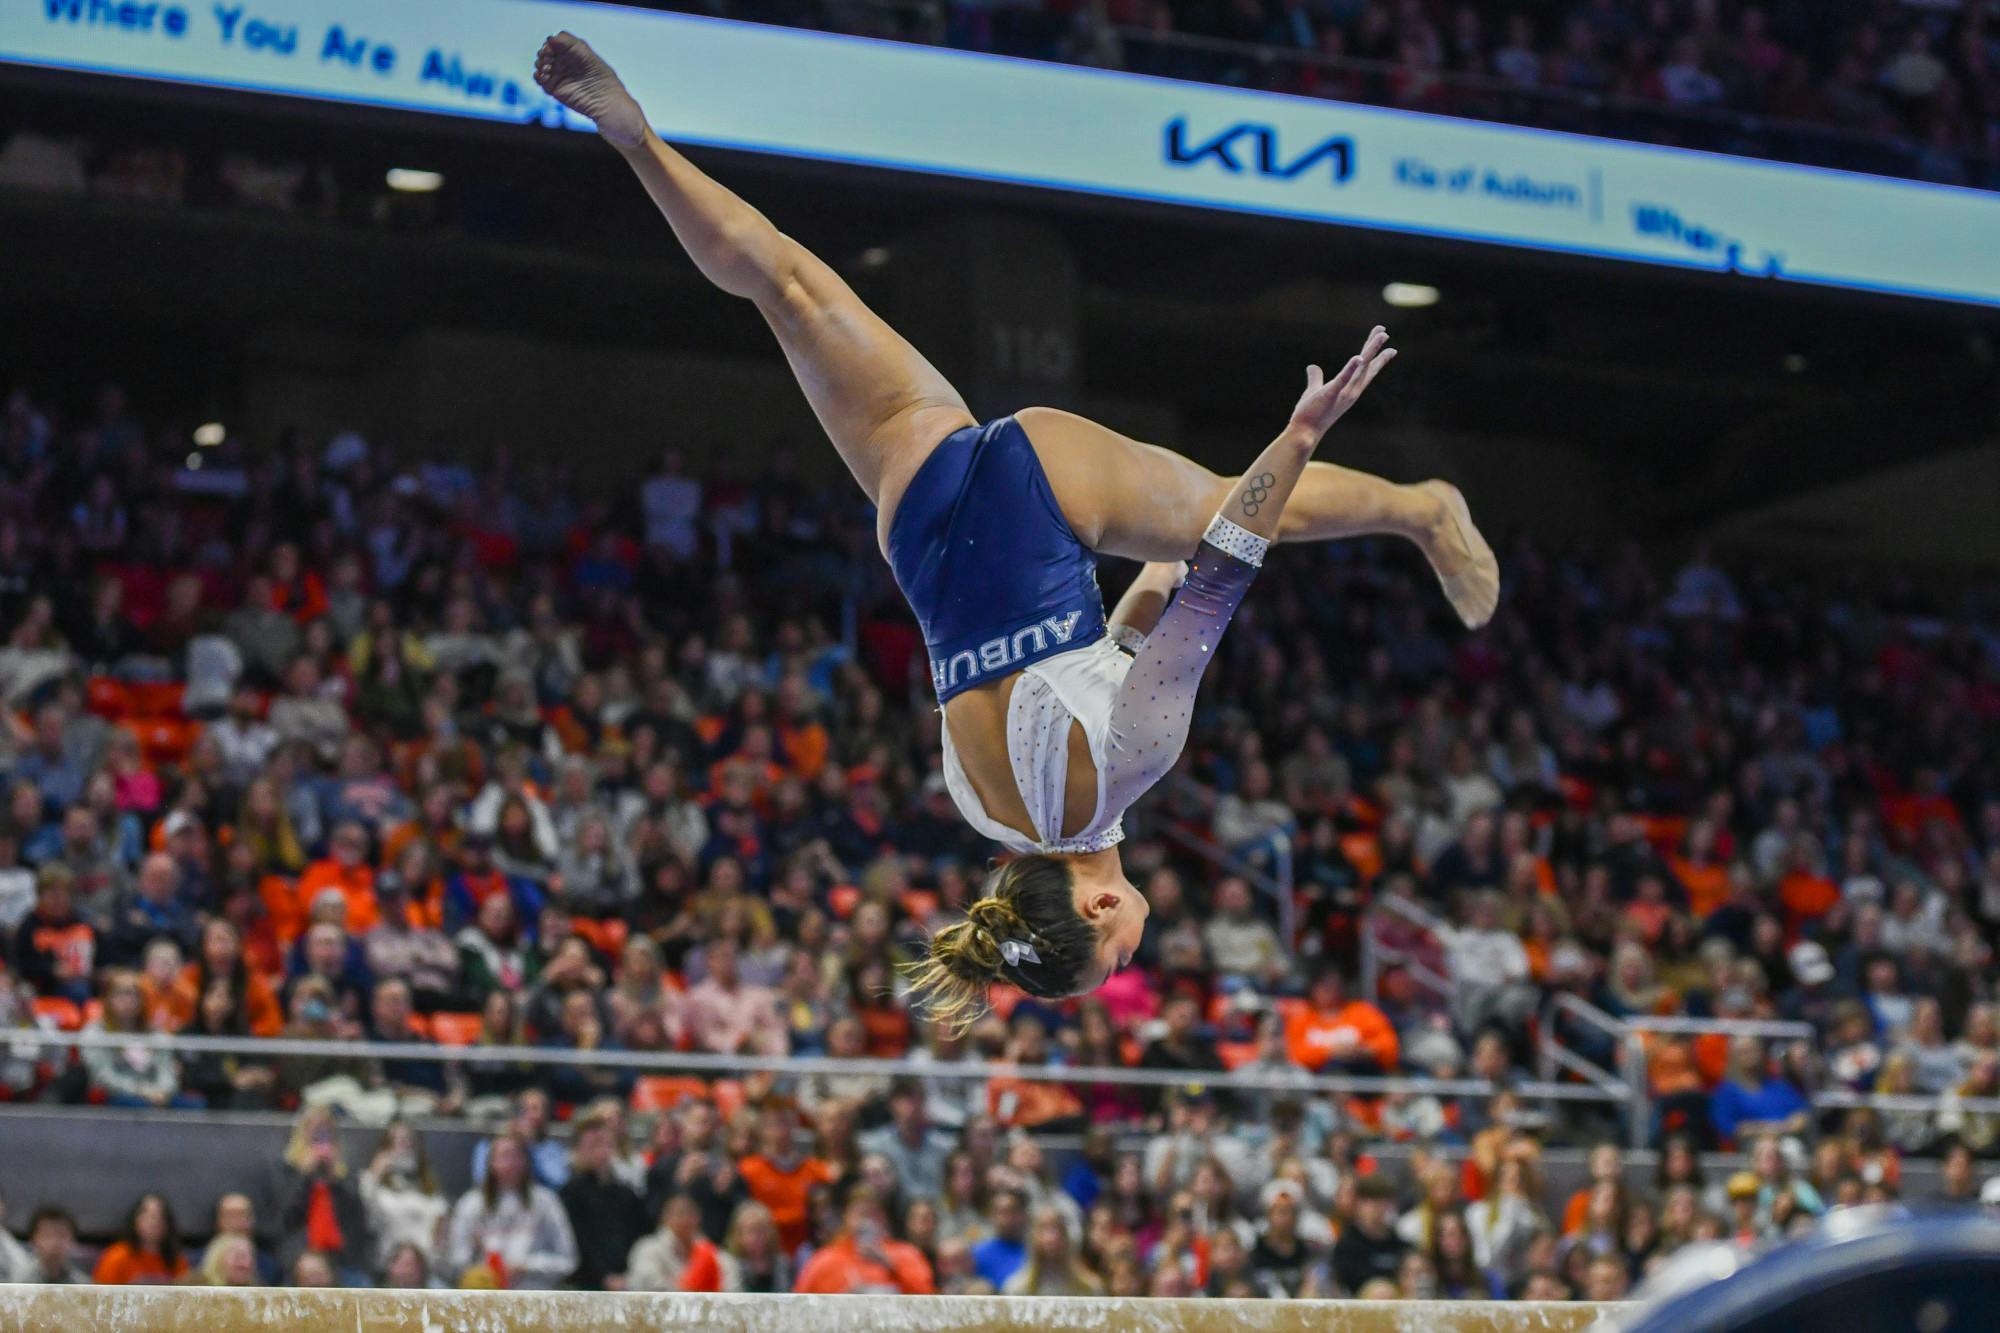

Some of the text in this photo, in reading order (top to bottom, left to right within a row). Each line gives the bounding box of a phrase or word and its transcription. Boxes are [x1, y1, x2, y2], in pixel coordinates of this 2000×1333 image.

[213, 6, 296, 53] You
[321, 26, 394, 73] Are
[1165, 116, 1354, 183] KIA
